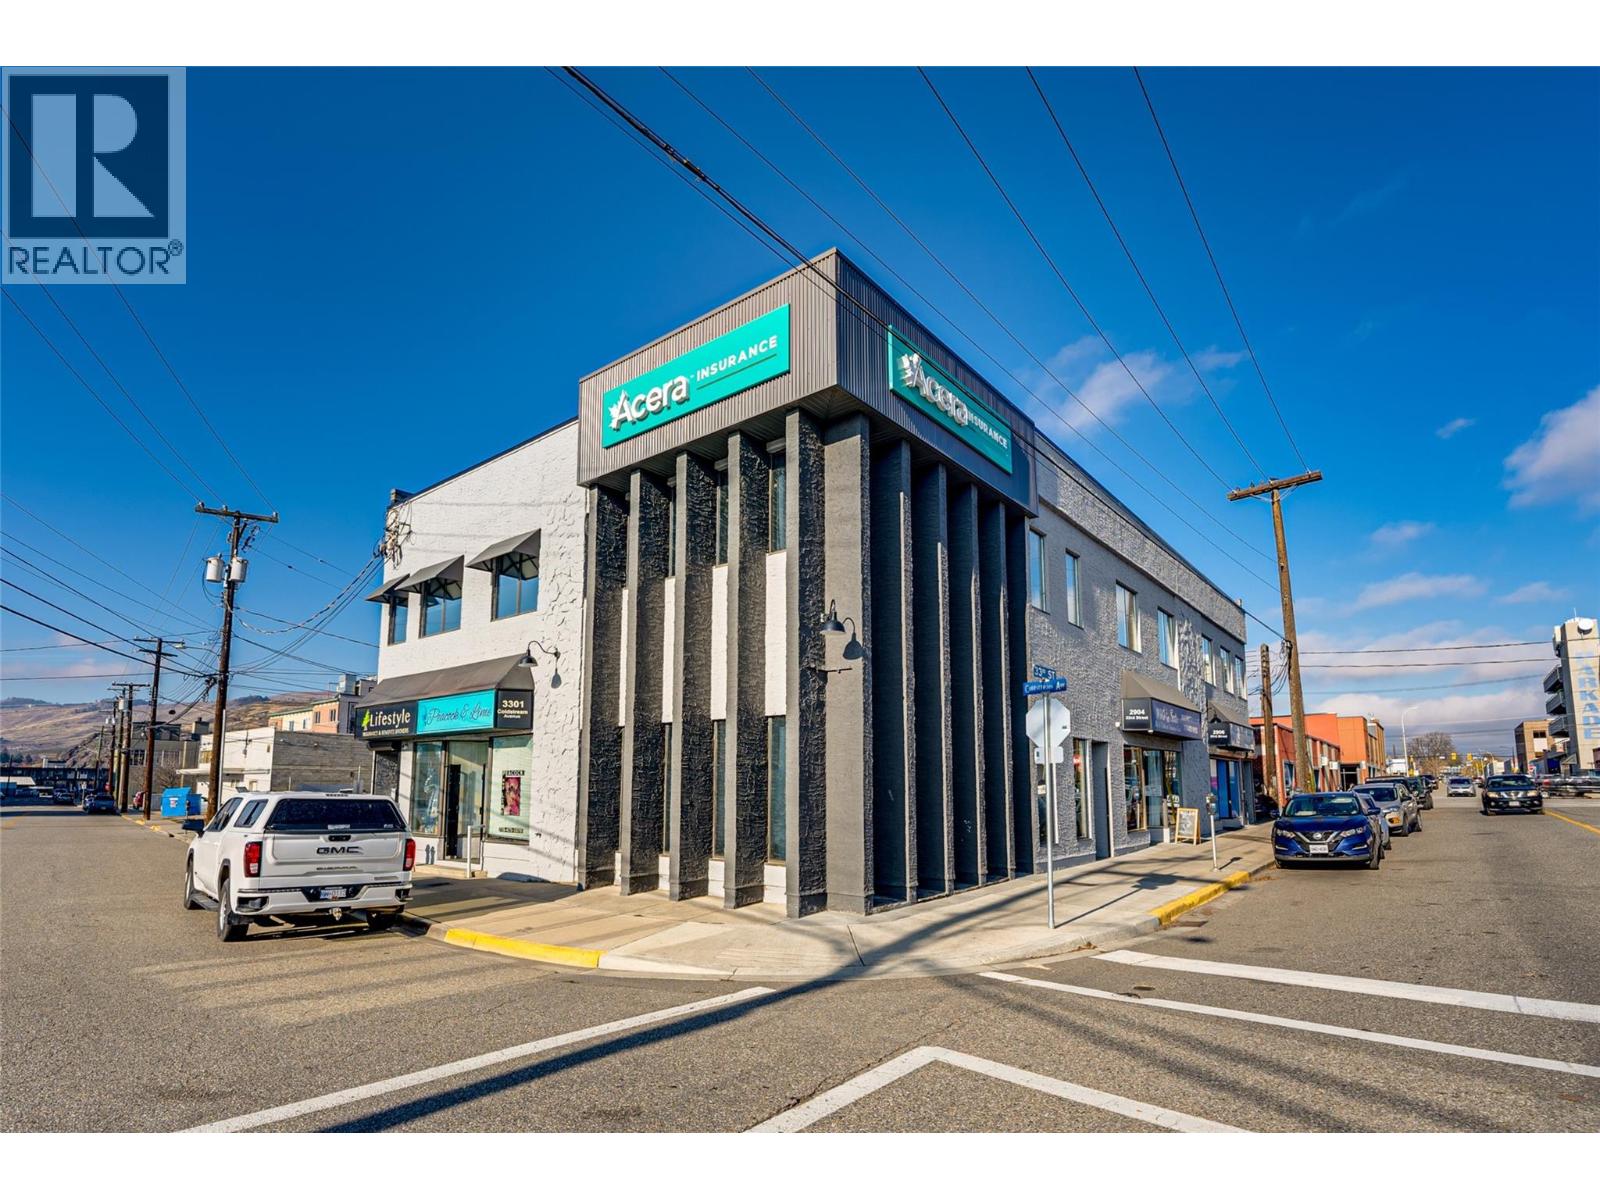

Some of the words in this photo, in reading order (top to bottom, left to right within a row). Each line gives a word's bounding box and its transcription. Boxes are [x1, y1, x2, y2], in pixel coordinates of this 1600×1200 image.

[611, 375, 690, 430] Acera
[696, 335, 778, 382] INSURANCE
[910, 363, 969, 427] Acera
[502, 700, 525, 708] 3301
[370, 708, 411, 728] Lifestyle
[316, 846, 364, 855] GMC
